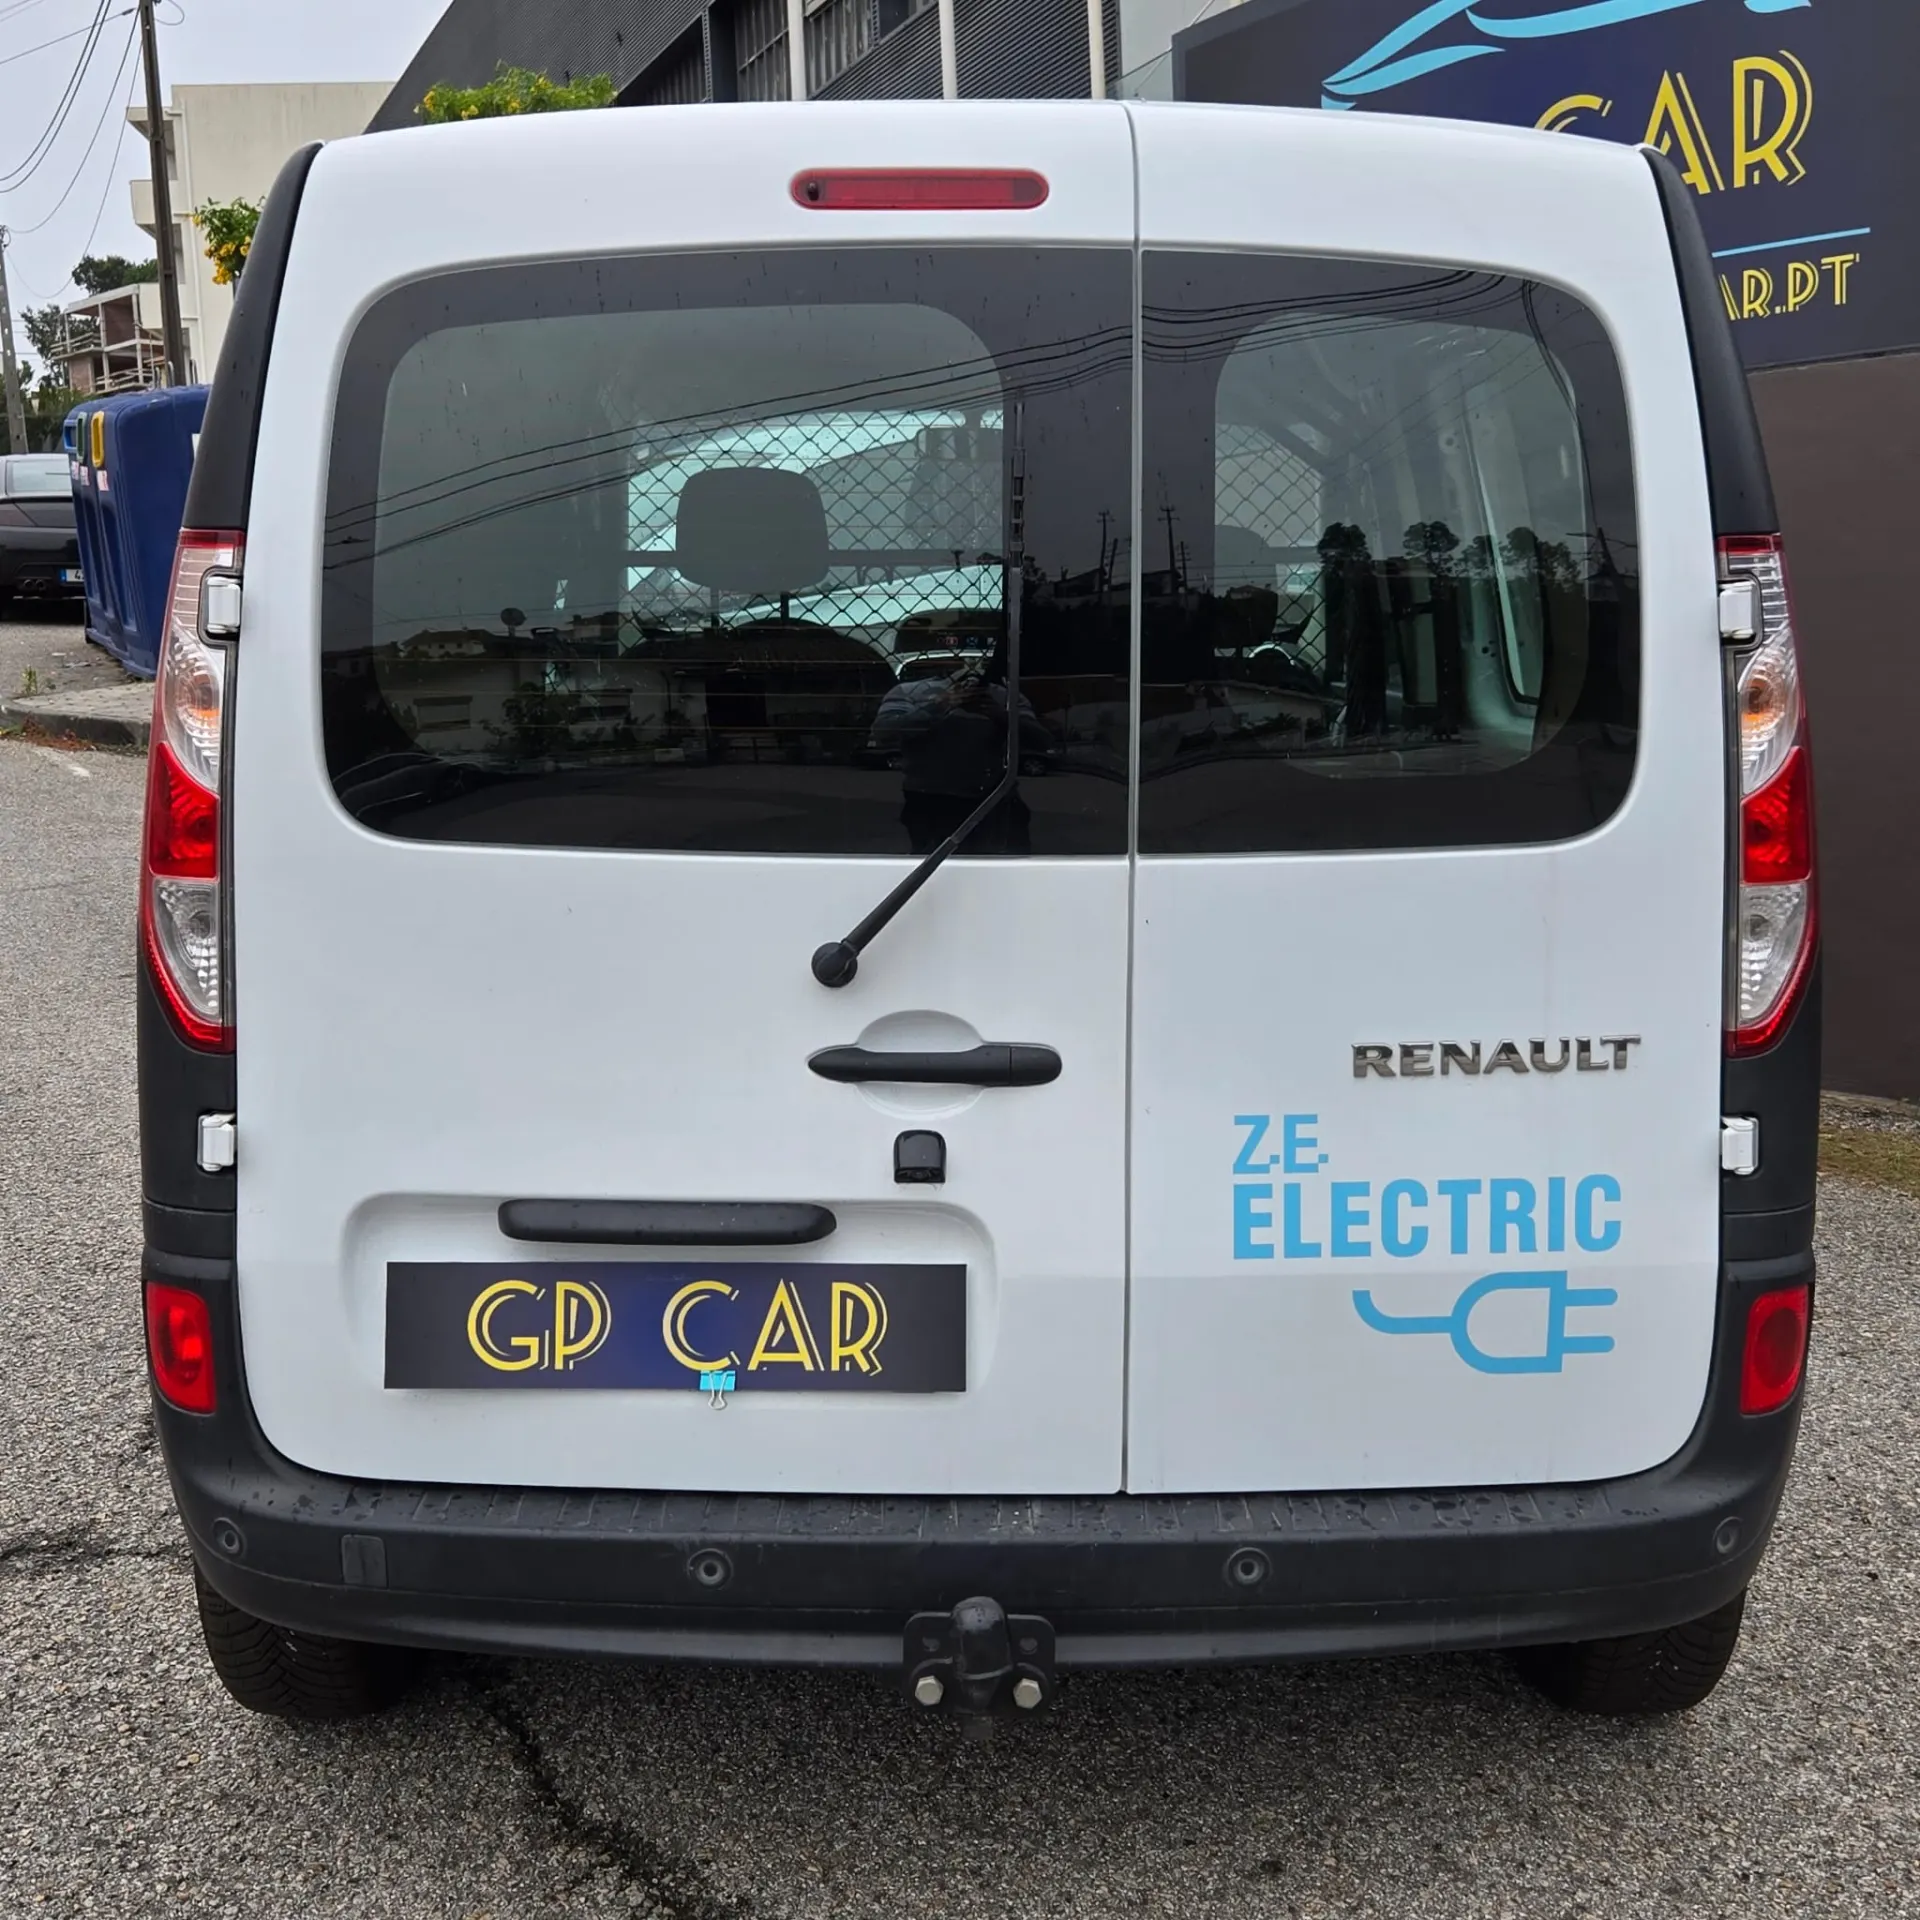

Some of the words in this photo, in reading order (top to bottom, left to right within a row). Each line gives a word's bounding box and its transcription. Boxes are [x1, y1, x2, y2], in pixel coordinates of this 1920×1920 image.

[1351, 1034, 1641, 1078] RENAULT
[1233, 1114, 1329, 1175] Z.E.
[1233, 1174, 1621, 1259] ELECTRIC
[467, 1279, 612, 1372] GP
[662, 1278, 888, 1376] CAR
